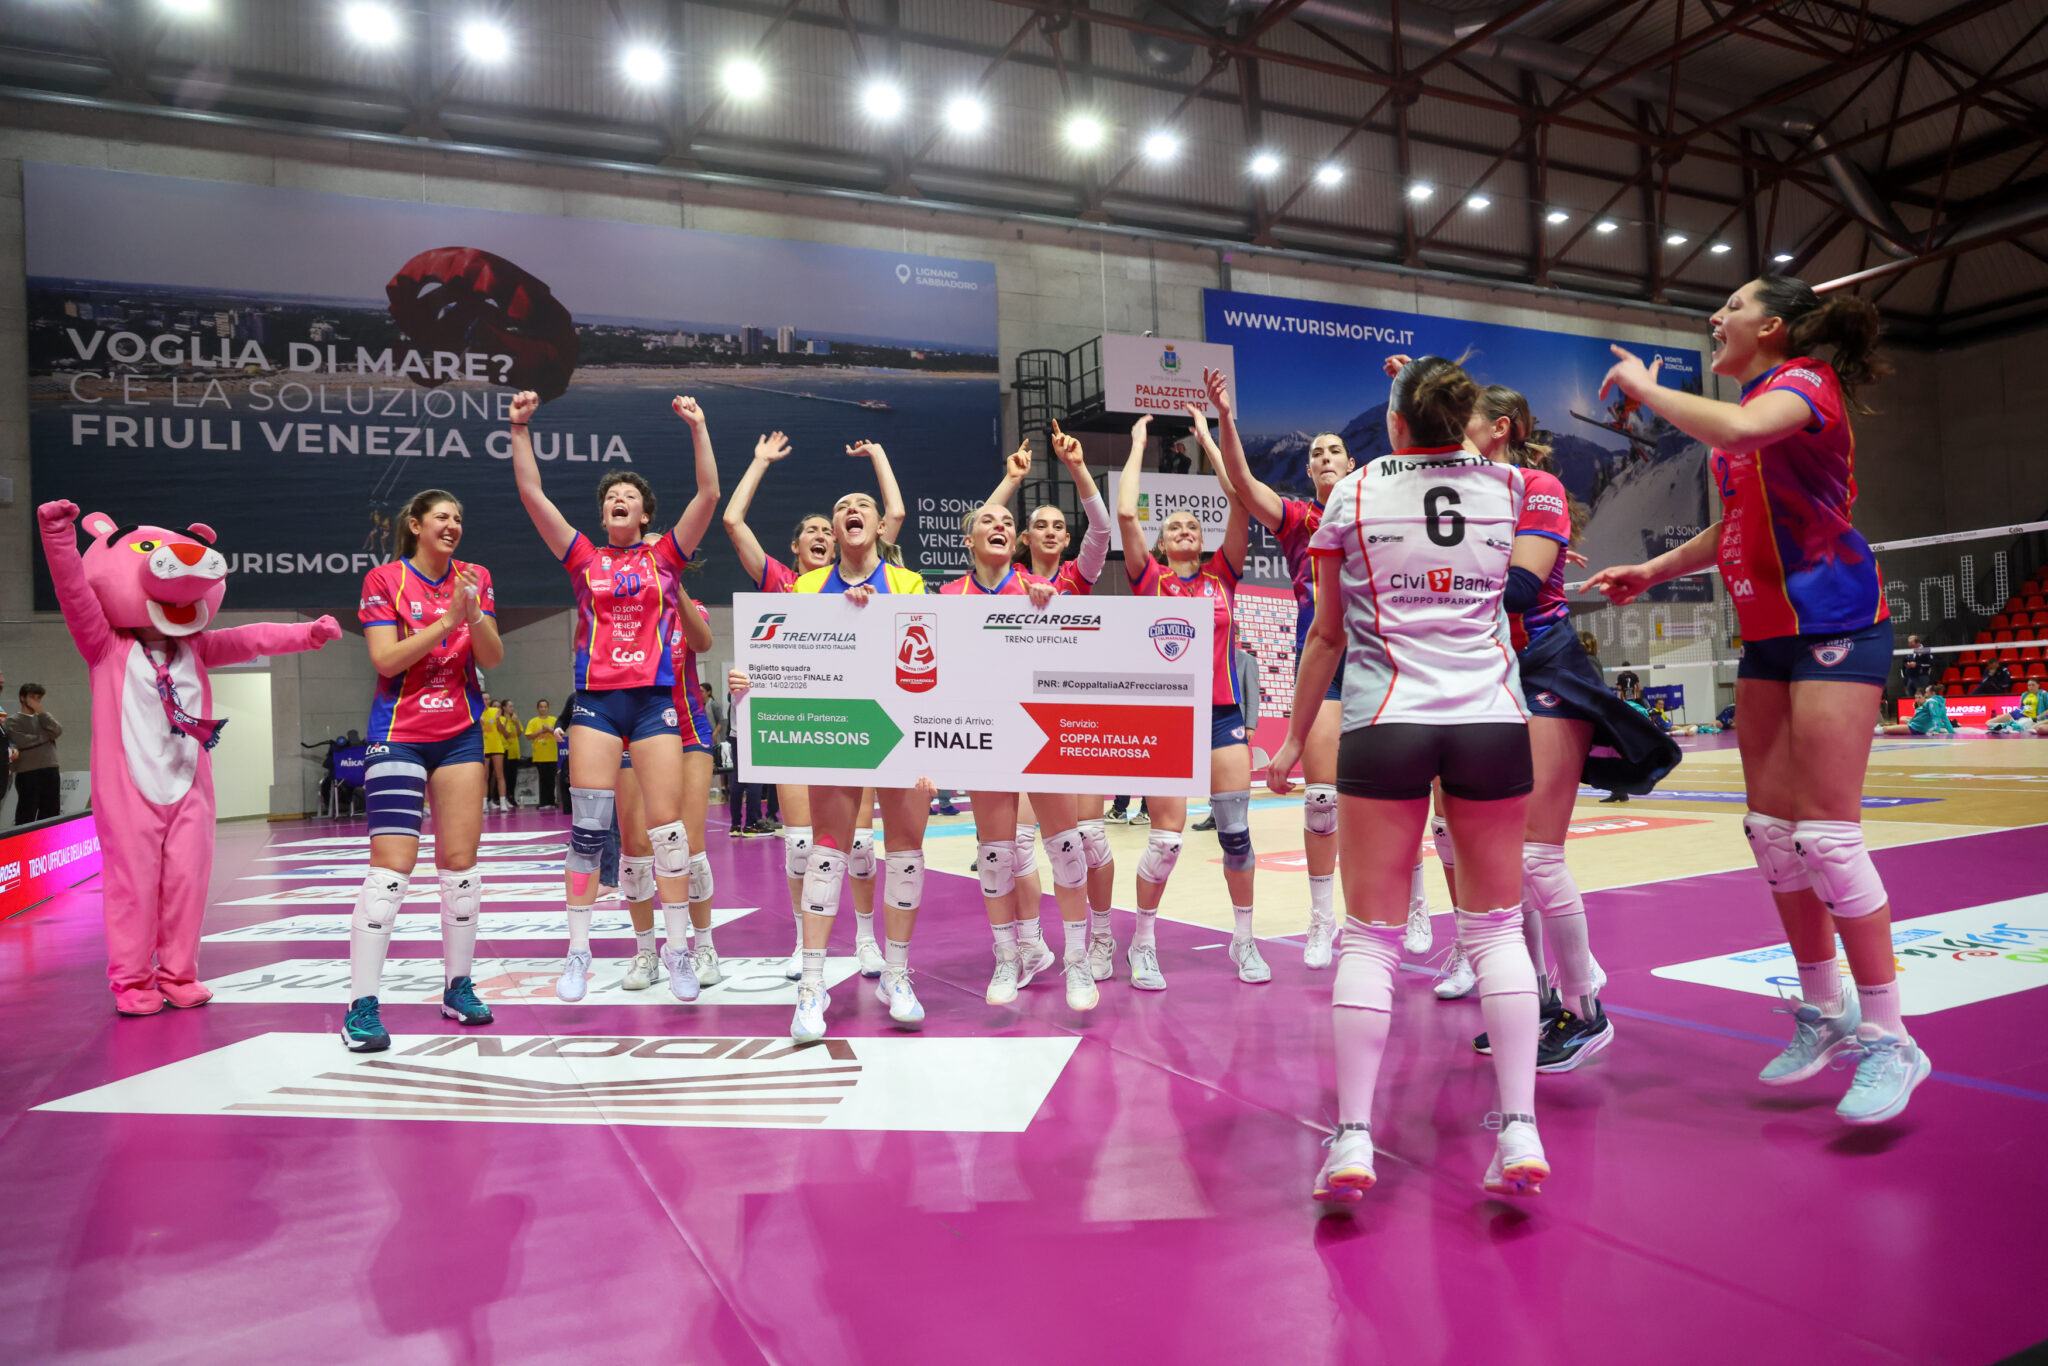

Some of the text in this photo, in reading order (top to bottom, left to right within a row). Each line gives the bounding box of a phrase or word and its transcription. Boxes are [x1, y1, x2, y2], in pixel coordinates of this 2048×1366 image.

[915, 267, 958, 279] LIGNANO
[915, 277, 978, 290] SABBIADORO
[1224, 310, 1414, 345] WWW.TURISMOFVG.IT
[66, 328, 514, 383] VOGLIA DI MARE?
[172, 376, 232, 409] LA
[1136, 384, 1206, 399] PALAZZETTO
[1135, 397, 1171, 409] DELLO
[72, 413, 632, 463] FRIULI VENEZIA GULIA
[918, 498, 935, 512] IO
[1155, 494, 1228, 508] EMPORIO
[1527, 502, 1536, 511] di
[1423, 485, 1465, 547] 6
[919, 516, 960, 530] FRIULI
[1665, 525, 1675, 536] IO
[919, 533, 967, 547] VENEZ
[920, 551, 969, 565] GIULIA
[614, 572, 641, 598] 20
[1390, 573, 1493, 592] Civi Bank
[1391, 596, 1434, 604] GRUPPO
[622, 604, 643, 612] SONO
[612, 621, 641, 629] VENEZIA
[985, 614, 1101, 625] FRECCIAROSSA
[782, 632, 856, 642] TRENITALIA
[1005, 635, 1078, 644] TRENO UFFICIALE
[748, 664, 811, 673] Biglietto squadra
[749, 681, 767, 689] Data:
[1037, 679, 1189, 691] PNR: #CoppaItaliaA2Frecciarossa
[757, 712, 848, 722] Stazione di Partenza:
[913, 715, 994, 726] Stazione di Arrivo:
[1059, 719, 1099, 729] Servizio:
[758, 730, 870, 746] TALMASSONS
[914, 731, 993, 750] FINALE
[1059, 733, 1157, 745] COPPA ITALIA A2
[1060, 747, 1150, 759] FRECCIAROSSA
[28, 855, 48, 879] TRENO
[48, 847, 70, 872] UFFICIALE
[396, 1036, 858, 1060] VIDONI
